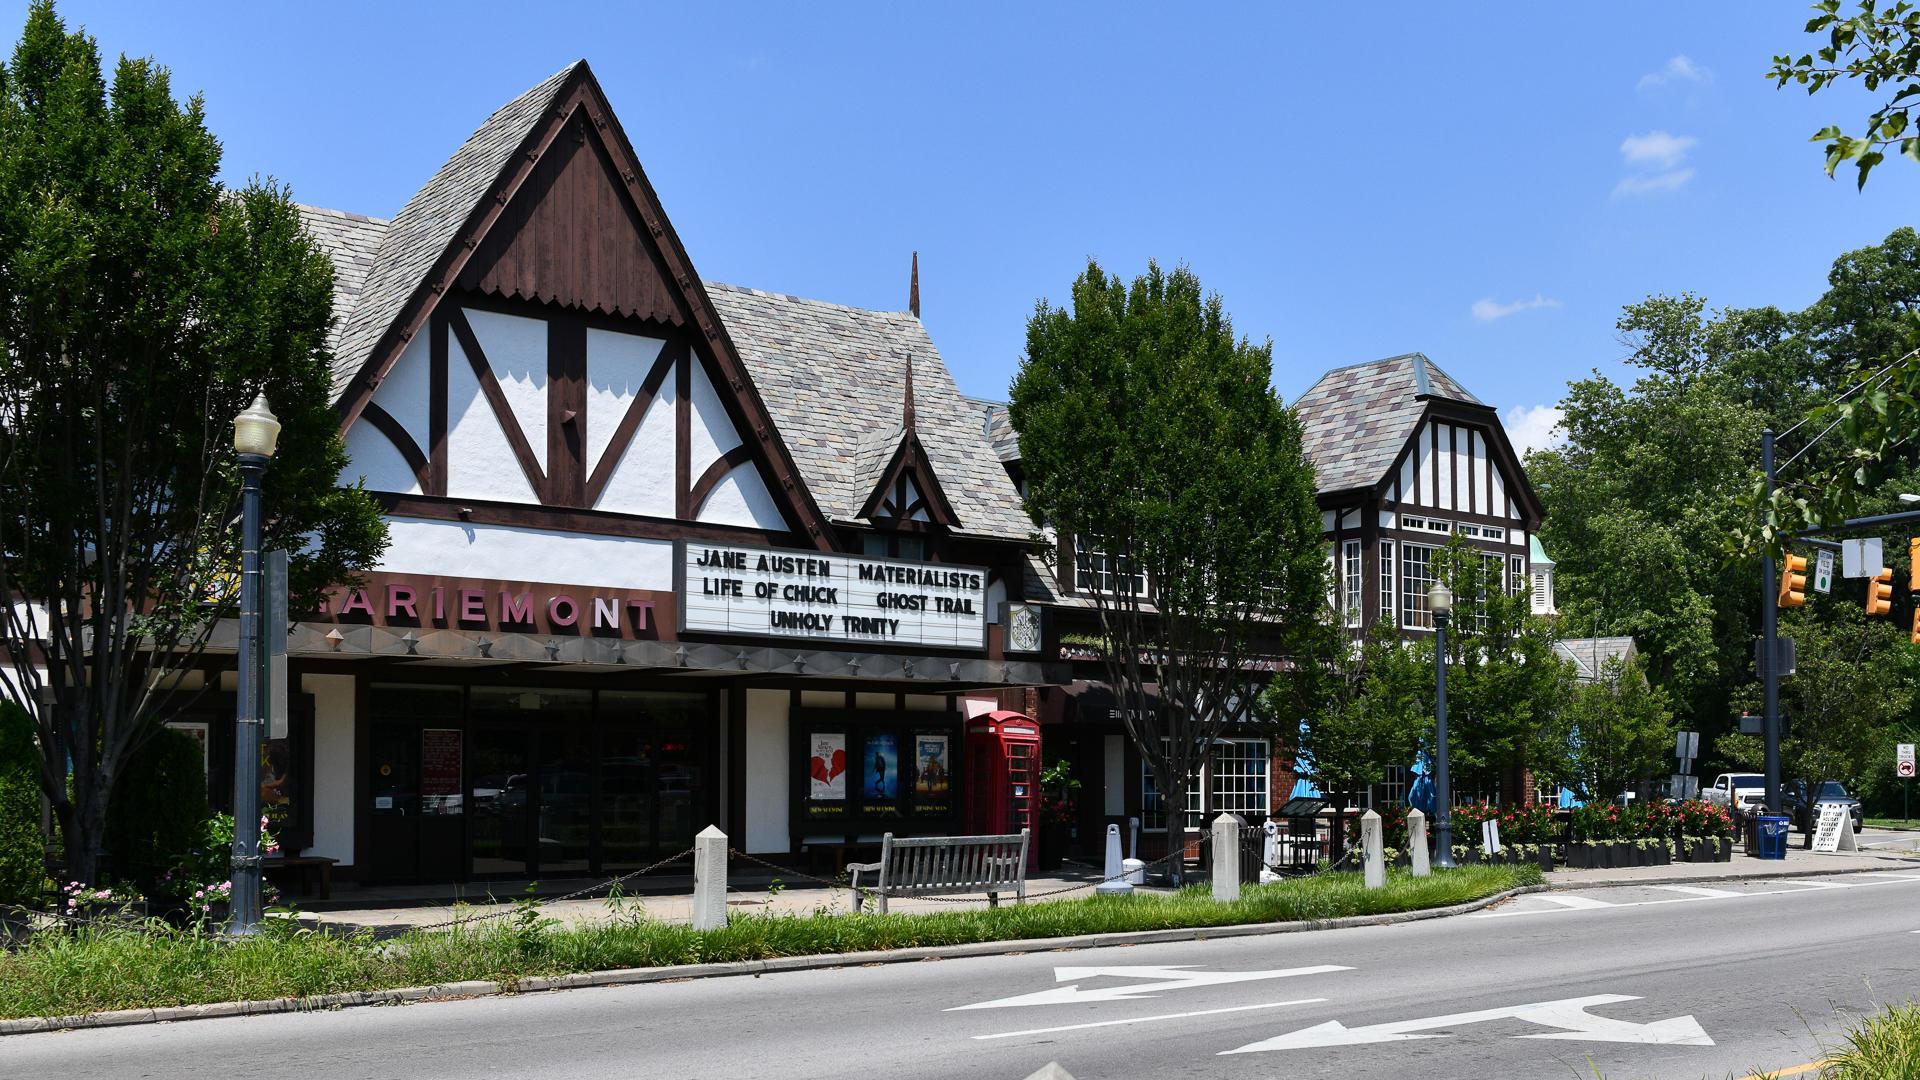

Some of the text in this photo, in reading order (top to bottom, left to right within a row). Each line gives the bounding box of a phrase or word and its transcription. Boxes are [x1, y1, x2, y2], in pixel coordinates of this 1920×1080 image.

[697, 549, 830, 577] JANE AUSTEN
[858, 563, 980, 590] MATERIALISTS
[703, 576, 838, 605] LIFE OF CHUCK
[876, 591, 976, 616] GHOST TRAIL
[316, 584, 656, 631] ARIEMONT
[771, 610, 899, 636] UNHOLY TRINITY
